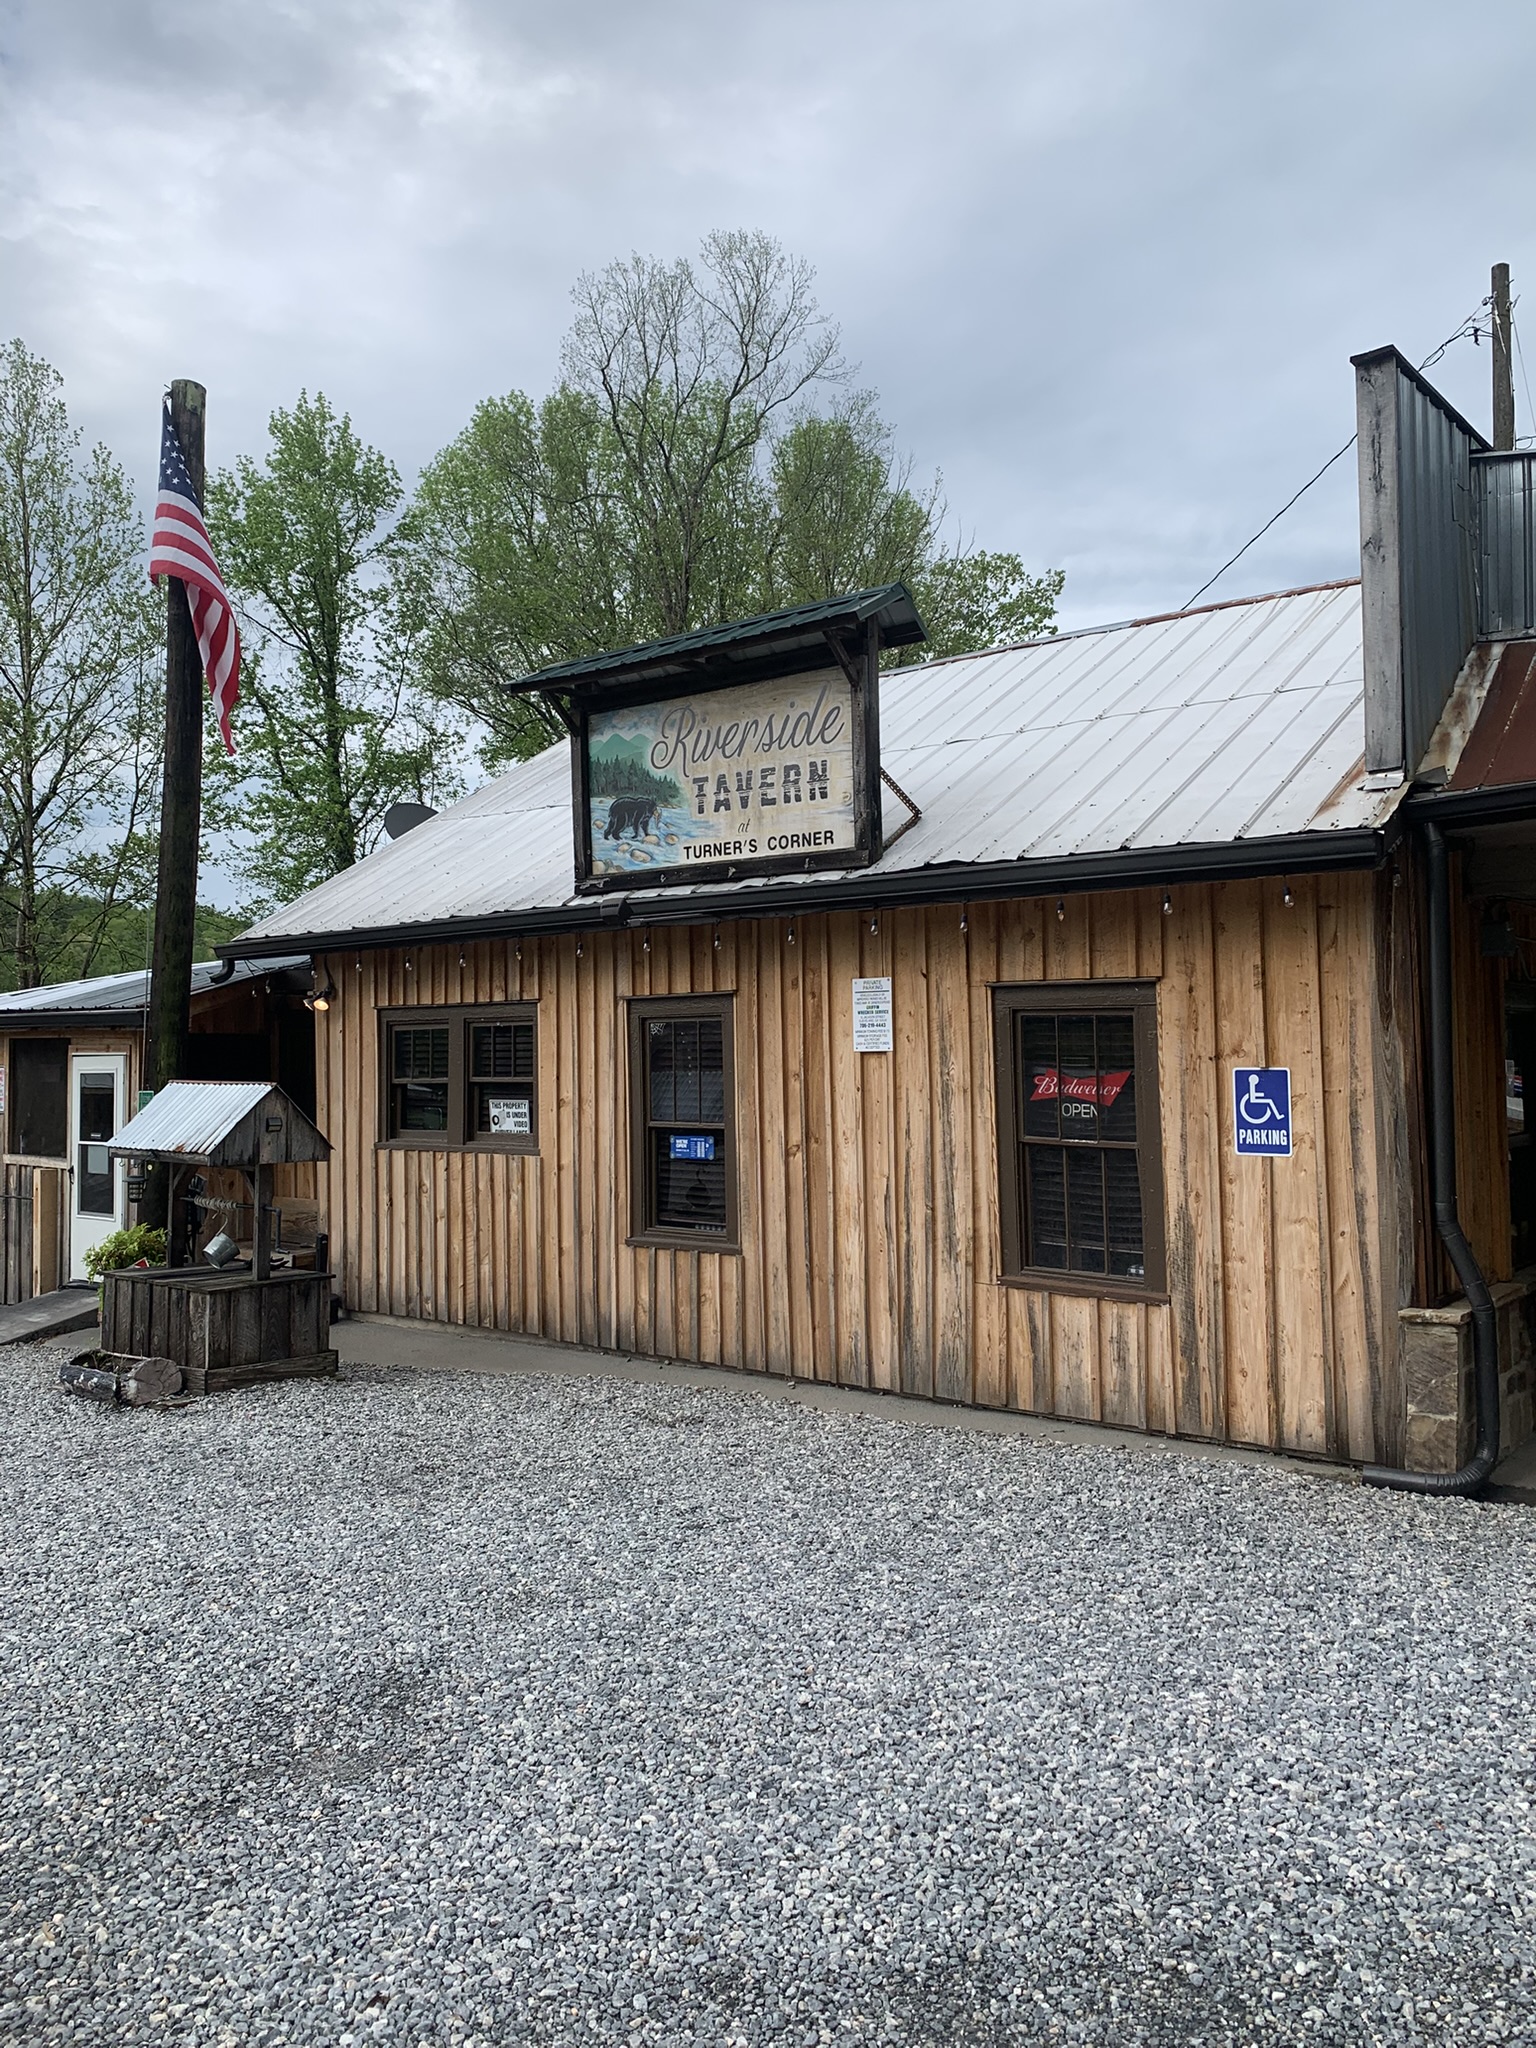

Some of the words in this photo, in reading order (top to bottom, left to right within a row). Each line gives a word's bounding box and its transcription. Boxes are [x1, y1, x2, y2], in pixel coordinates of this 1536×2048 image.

[651, 681, 845, 778] Riverside
[692, 759, 830, 815] TAVERN
[737, 818, 751, 833] at
[683, 838, 758, 860] TURNER'S
[767, 830, 835, 851] CORNER
[1239, 1129, 1287, 1145] PARKING
